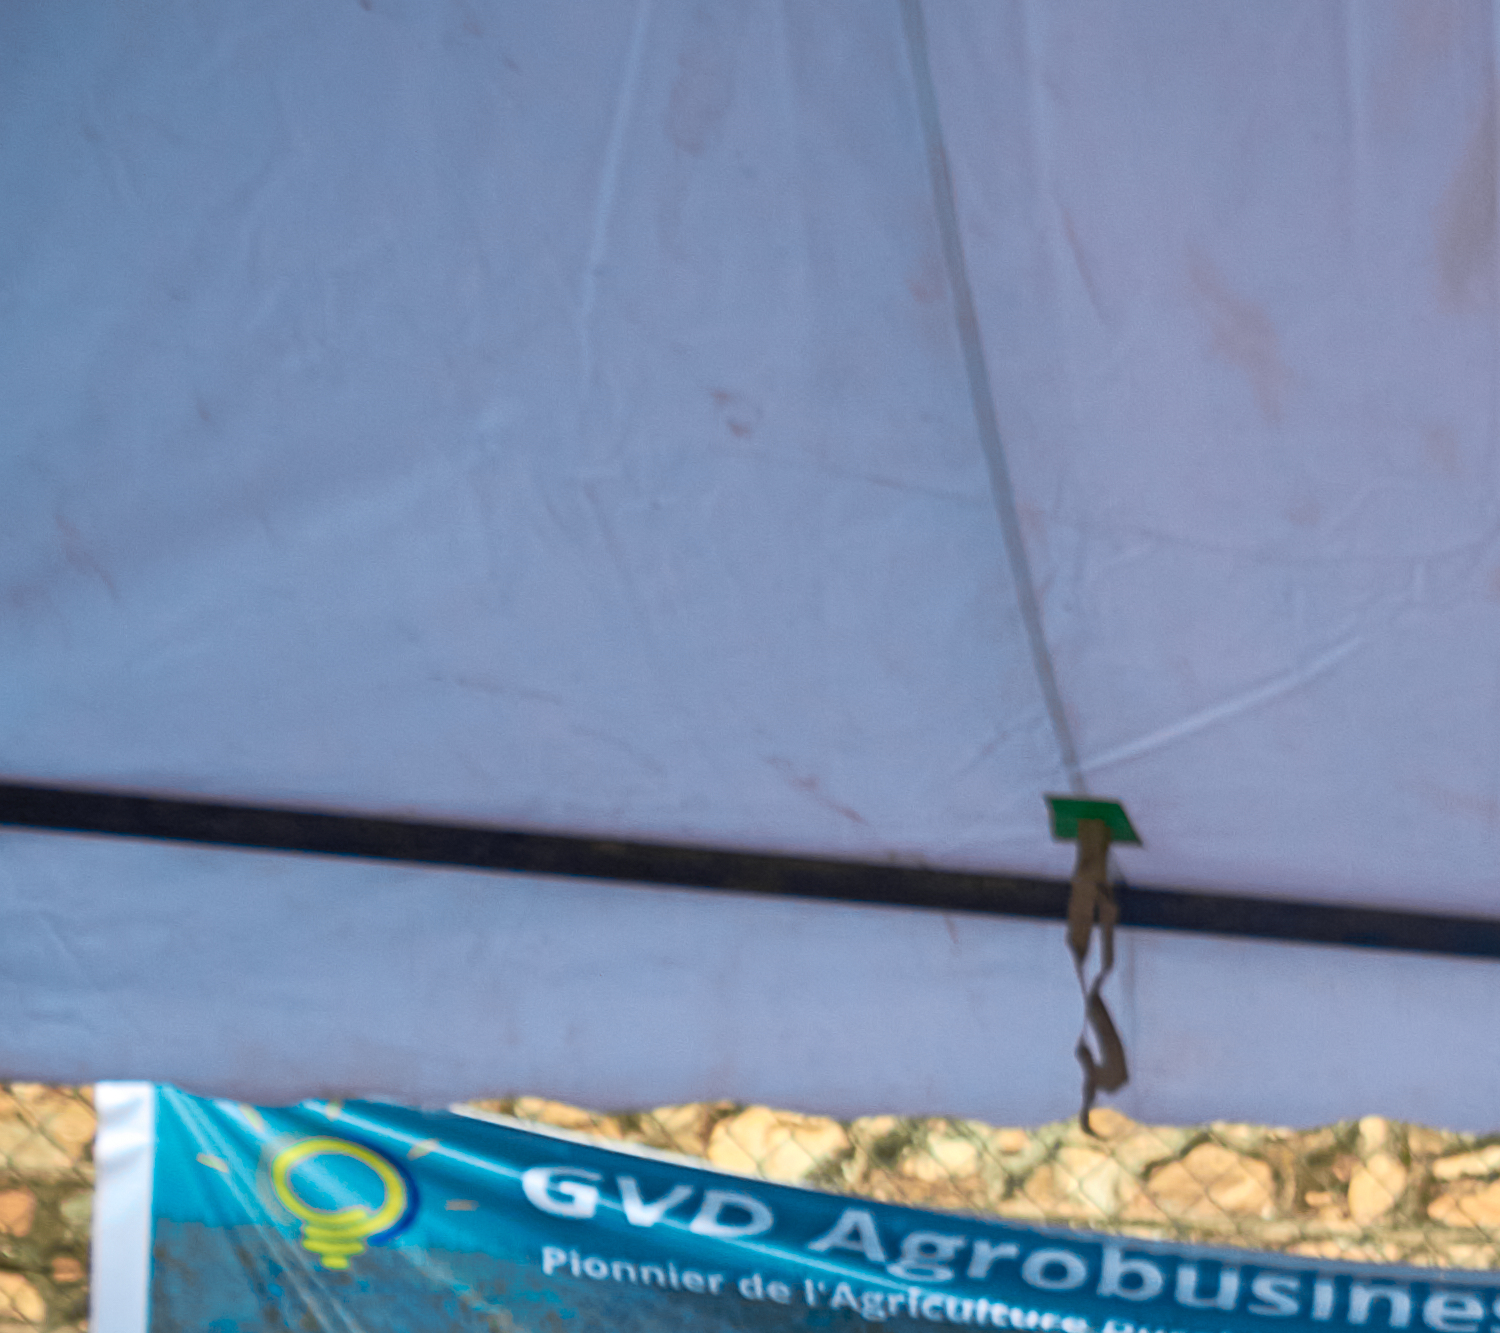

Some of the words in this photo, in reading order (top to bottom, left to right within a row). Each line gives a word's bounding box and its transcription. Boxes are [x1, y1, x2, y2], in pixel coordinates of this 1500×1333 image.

[521, 1166, 774, 1239] GVD
[541, 1246, 724, 1295] Pionnier
[738, 1272, 791, 1305] de
